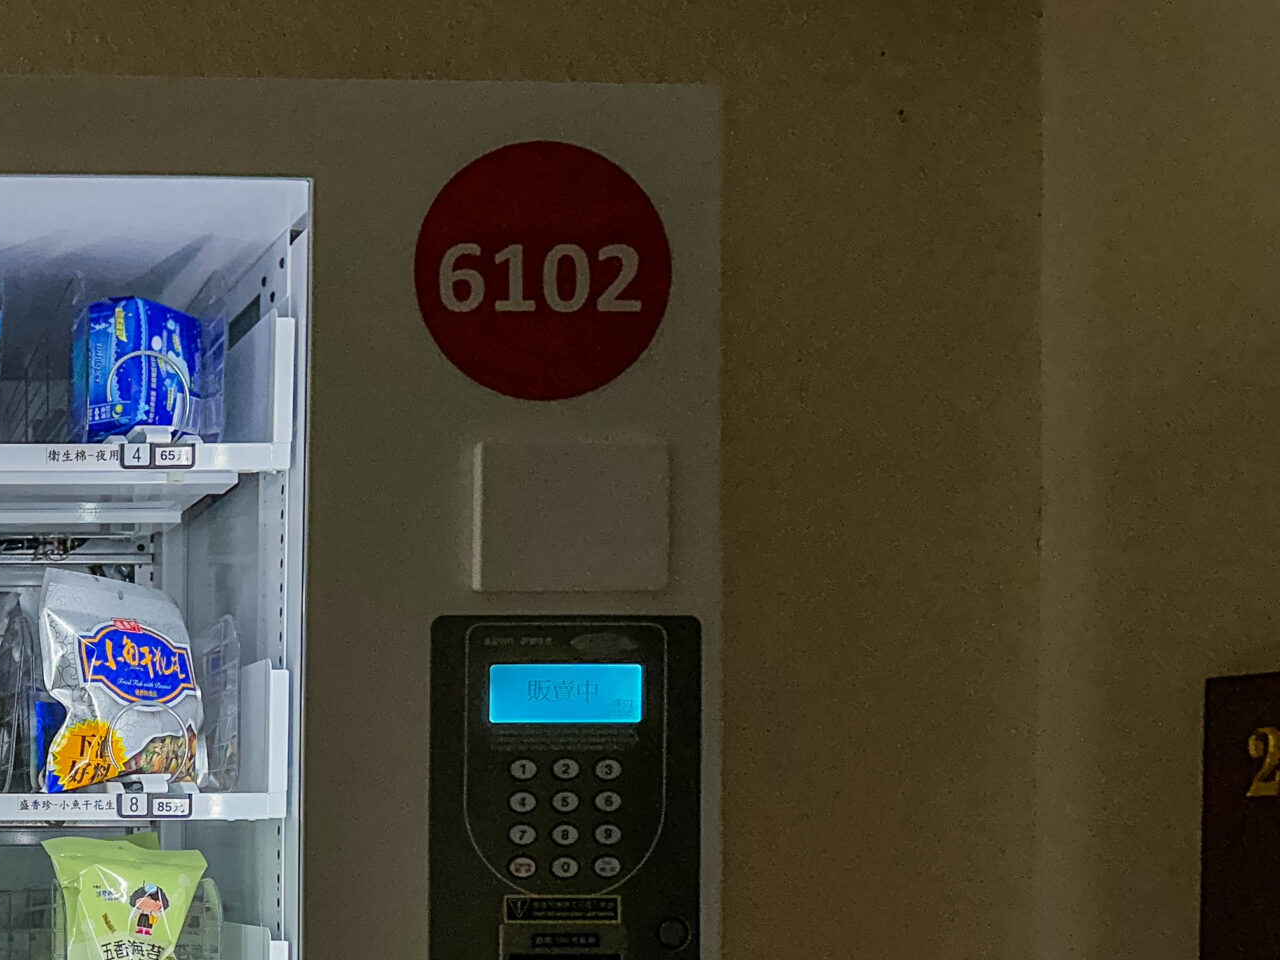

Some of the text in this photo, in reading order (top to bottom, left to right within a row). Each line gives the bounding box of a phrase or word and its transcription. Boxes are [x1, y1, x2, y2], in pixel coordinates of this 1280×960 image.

[438, 242, 643, 313] 6102
[132, 446, 142, 463] 4
[520, 763, 527, 777] 1
[561, 762, 570, 776] 2
[604, 763, 613, 777] 3
[129, 796, 139, 813] 8
[157, 801, 185, 814] 85元
[518, 796, 527, 809] 4
[560, 796, 570, 809] 5
[604, 795, 613, 808] 6
[518, 829, 527, 842] 7
[560, 829, 570, 842] 8
[604, 827, 613, 841] 9
[561, 861, 570, 874] 0
